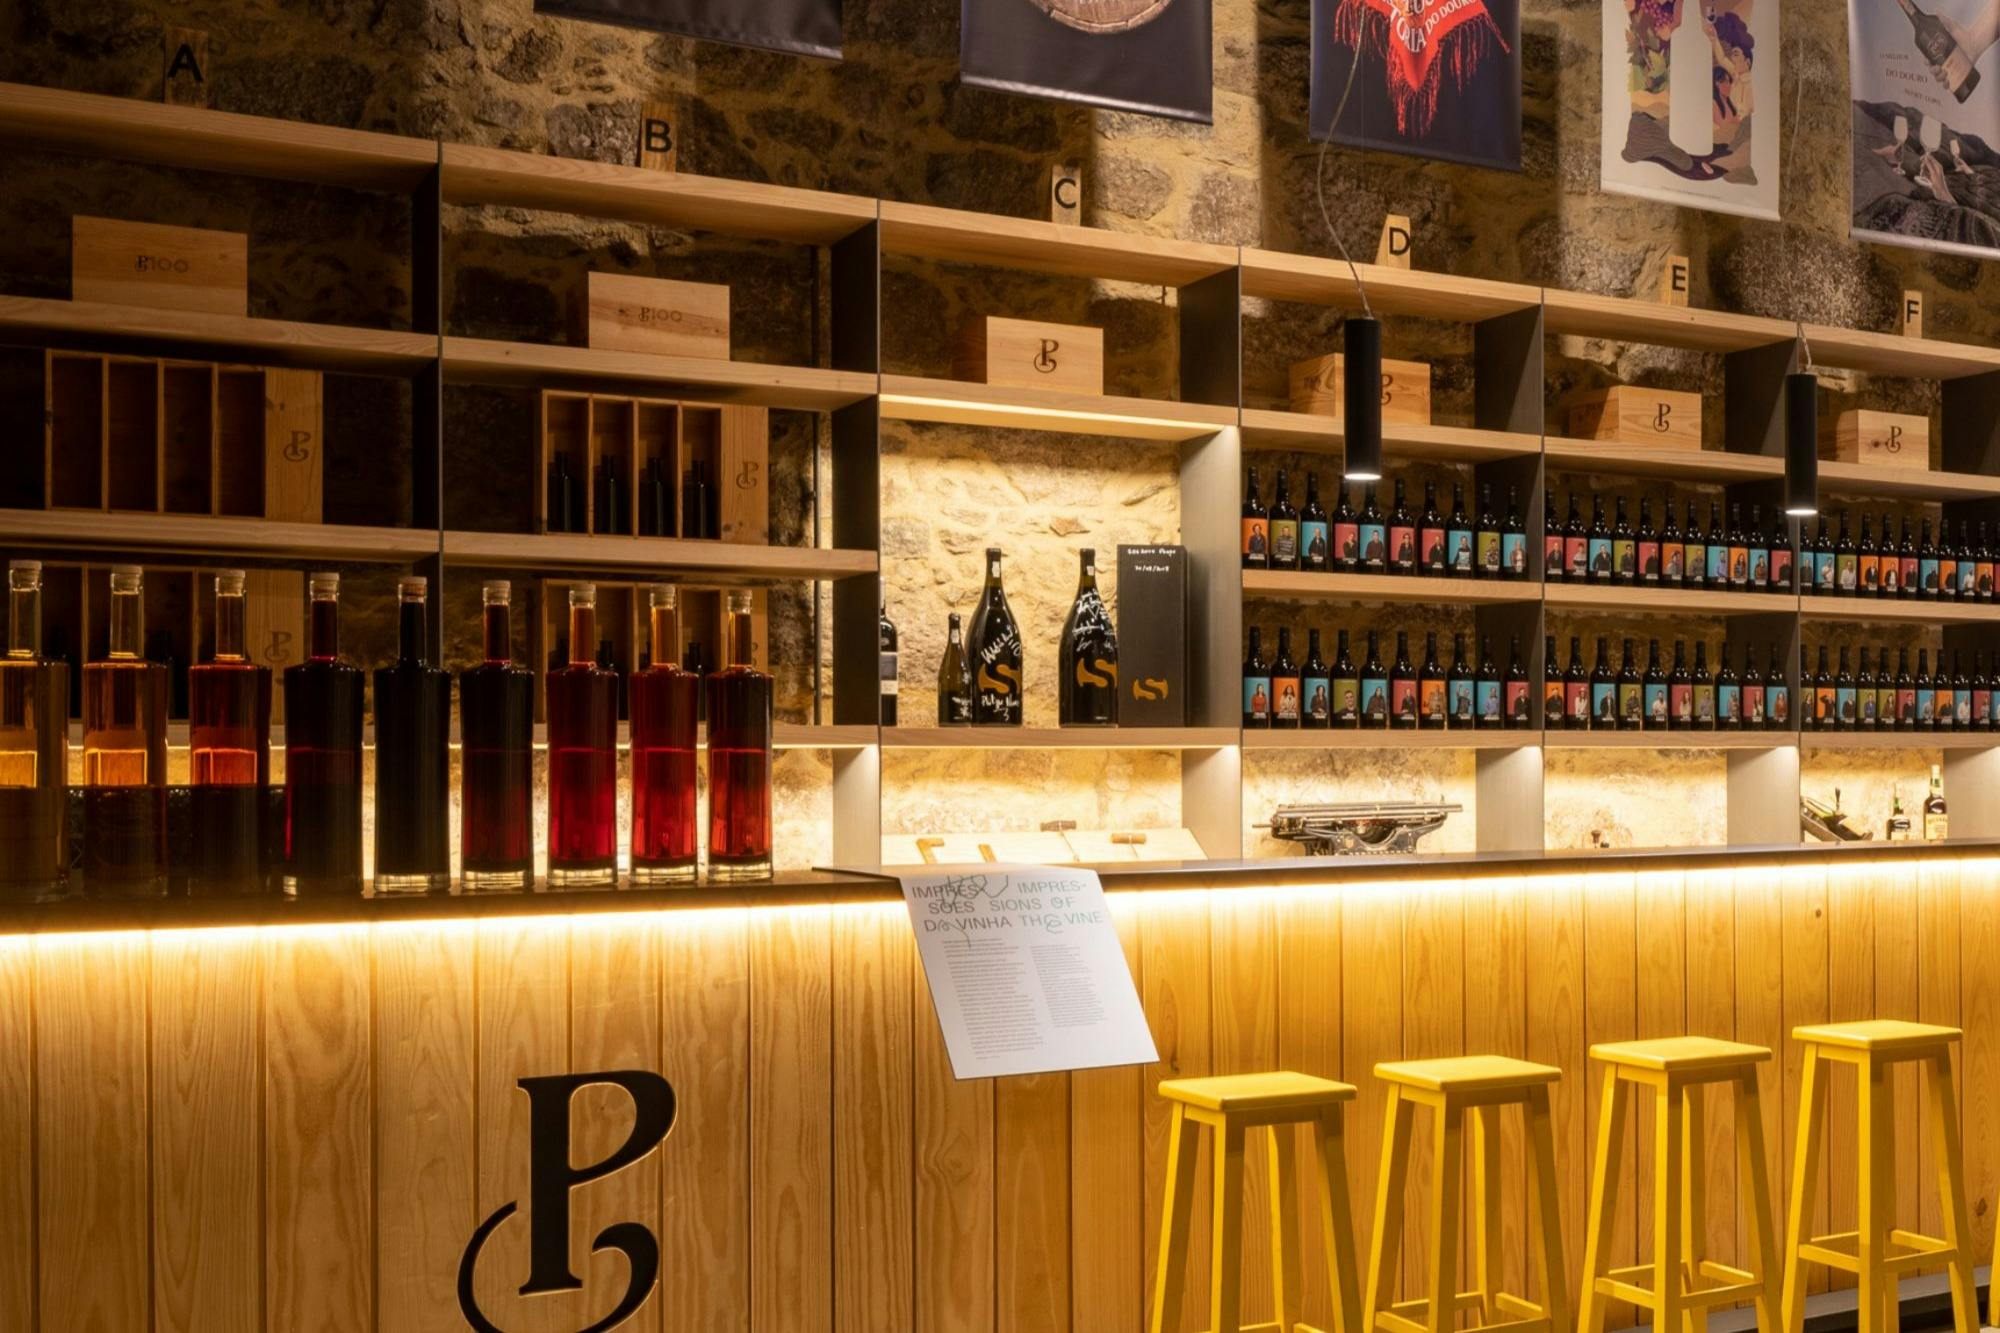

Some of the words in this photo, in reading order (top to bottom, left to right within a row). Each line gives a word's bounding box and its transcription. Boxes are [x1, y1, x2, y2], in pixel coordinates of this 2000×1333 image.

[167, 44, 204, 83] A
[646, 118, 673, 153] B
[1054, 177, 1077, 209] C
[1388, 226, 1411, 256] D
[1672, 265, 1687, 291] E
[1906, 299, 1919, 324] F
[1017, 880, 1088, 893] IMPRES-
[990, 897, 1042, 912] SIONS
[956, 916, 1012, 930] VINHA
[1064, 911, 1104, 924] VINE
